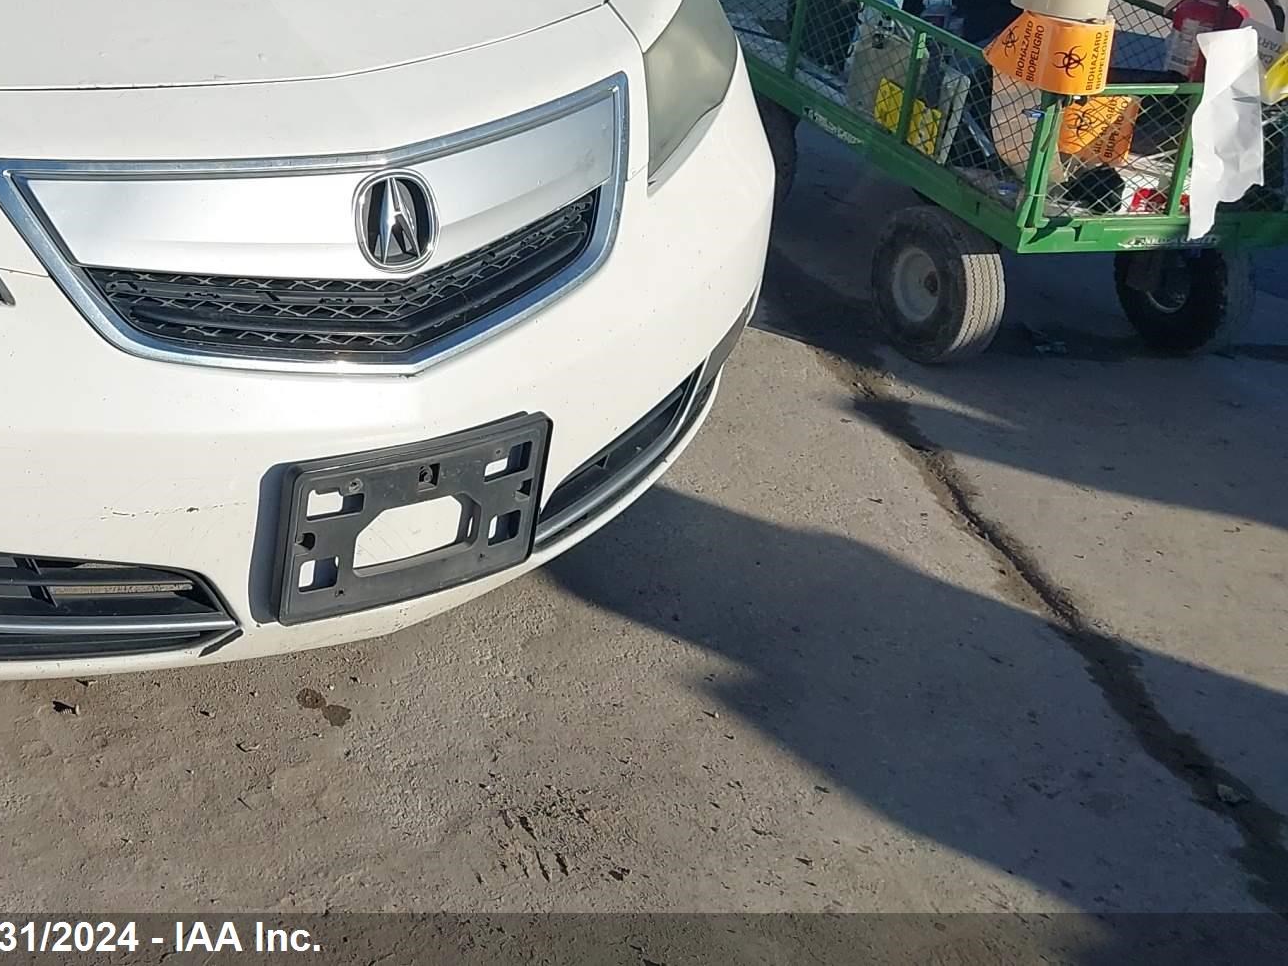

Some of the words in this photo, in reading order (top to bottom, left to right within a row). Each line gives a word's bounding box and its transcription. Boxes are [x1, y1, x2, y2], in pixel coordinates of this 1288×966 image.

[1016, 20, 1034, 77] BIOHAZARD
[1026, 25, 1045, 82] BIOPELIGRO
[1086, 31, 1103, 91] BIOHAZARD
